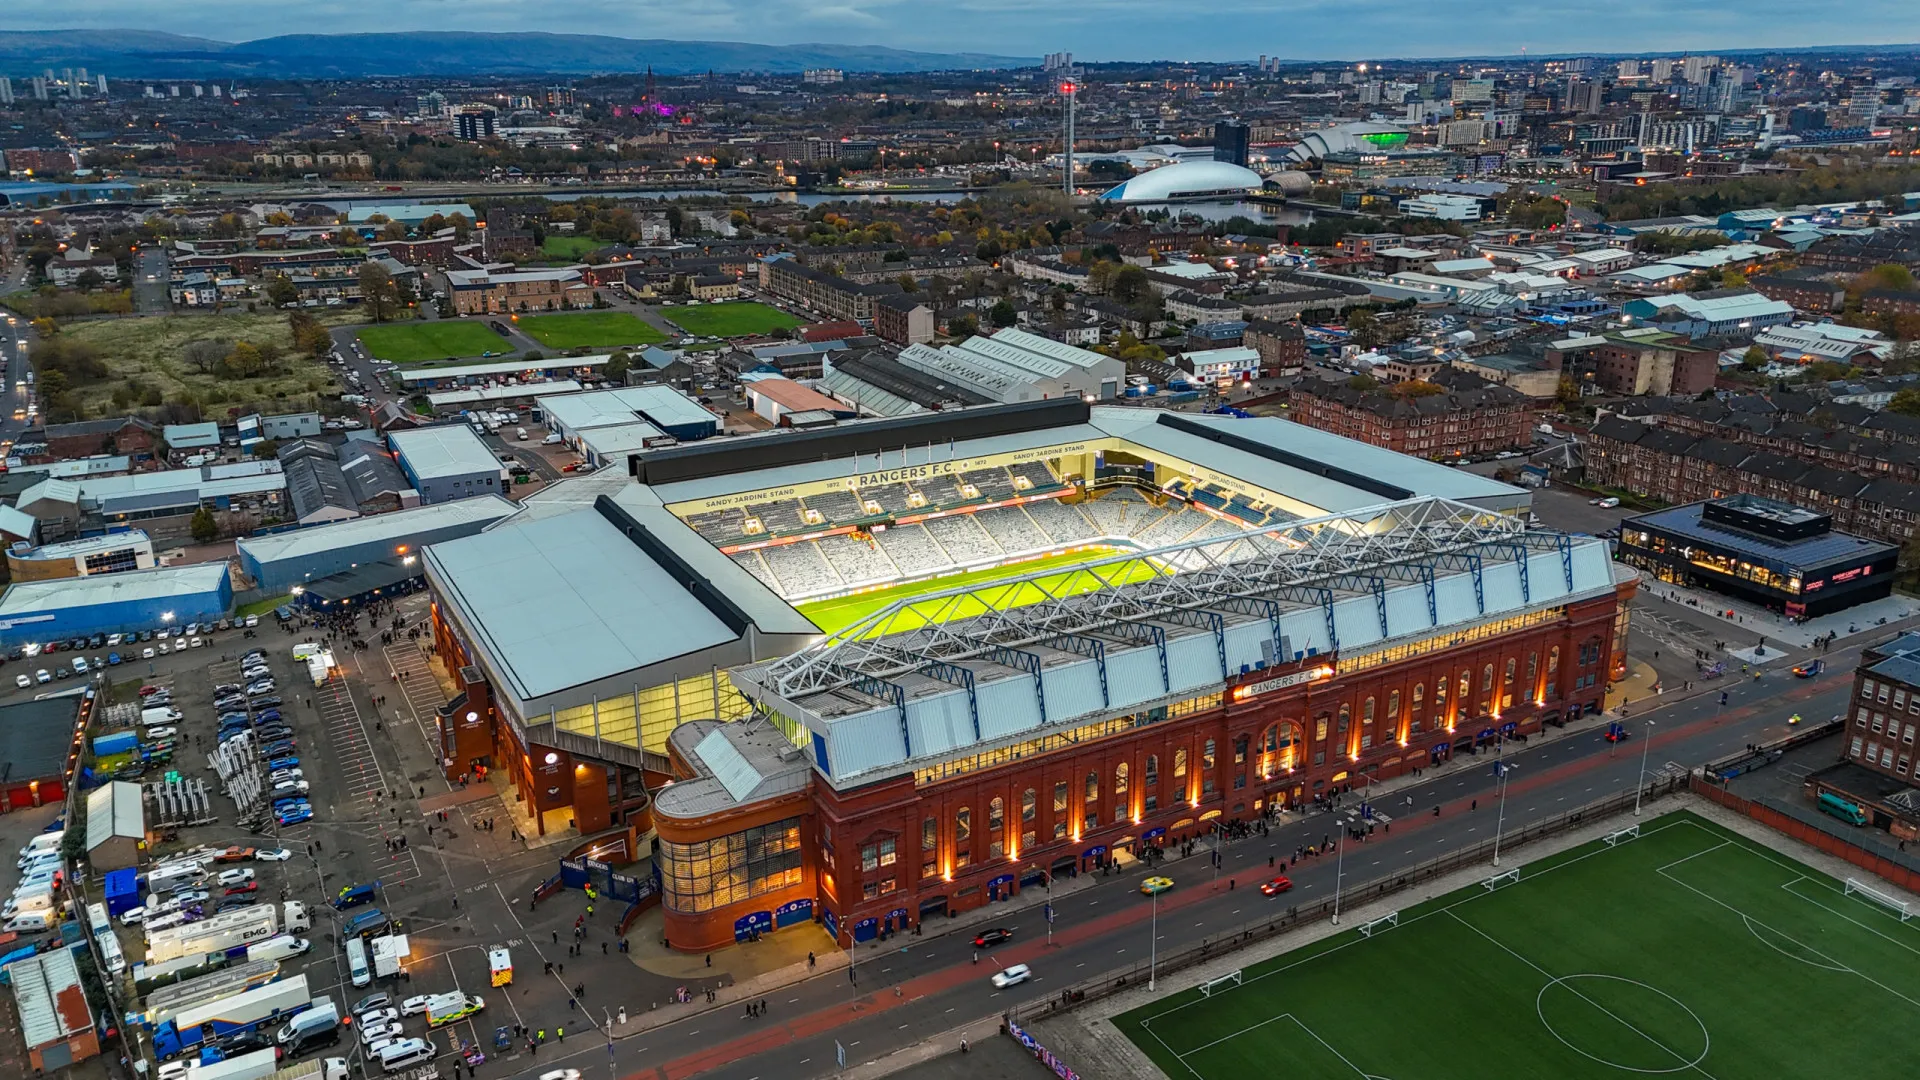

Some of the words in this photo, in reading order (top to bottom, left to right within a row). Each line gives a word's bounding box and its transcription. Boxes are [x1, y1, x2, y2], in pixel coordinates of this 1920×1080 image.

[1013, 452, 1035, 460] SANDY
[1036, 448, 1063, 457] JARDINE
[1064, 445, 1085, 453] STAND
[859, 467, 927, 486] RANGERS
[932, 463, 956, 475] F.C.
[1208, 473, 1230, 486] COPLAND
[1230, 481, 1246, 491] STAND
[705, 499, 732, 508] SANDY
[734, 493, 768, 504] JARDINE
[769, 488, 795, 498] STAND
[1250, 676, 1294, 694] RANGERS
[562, 861, 584, 871] FOOTBALL
[243, 927, 268, 939] EMG
